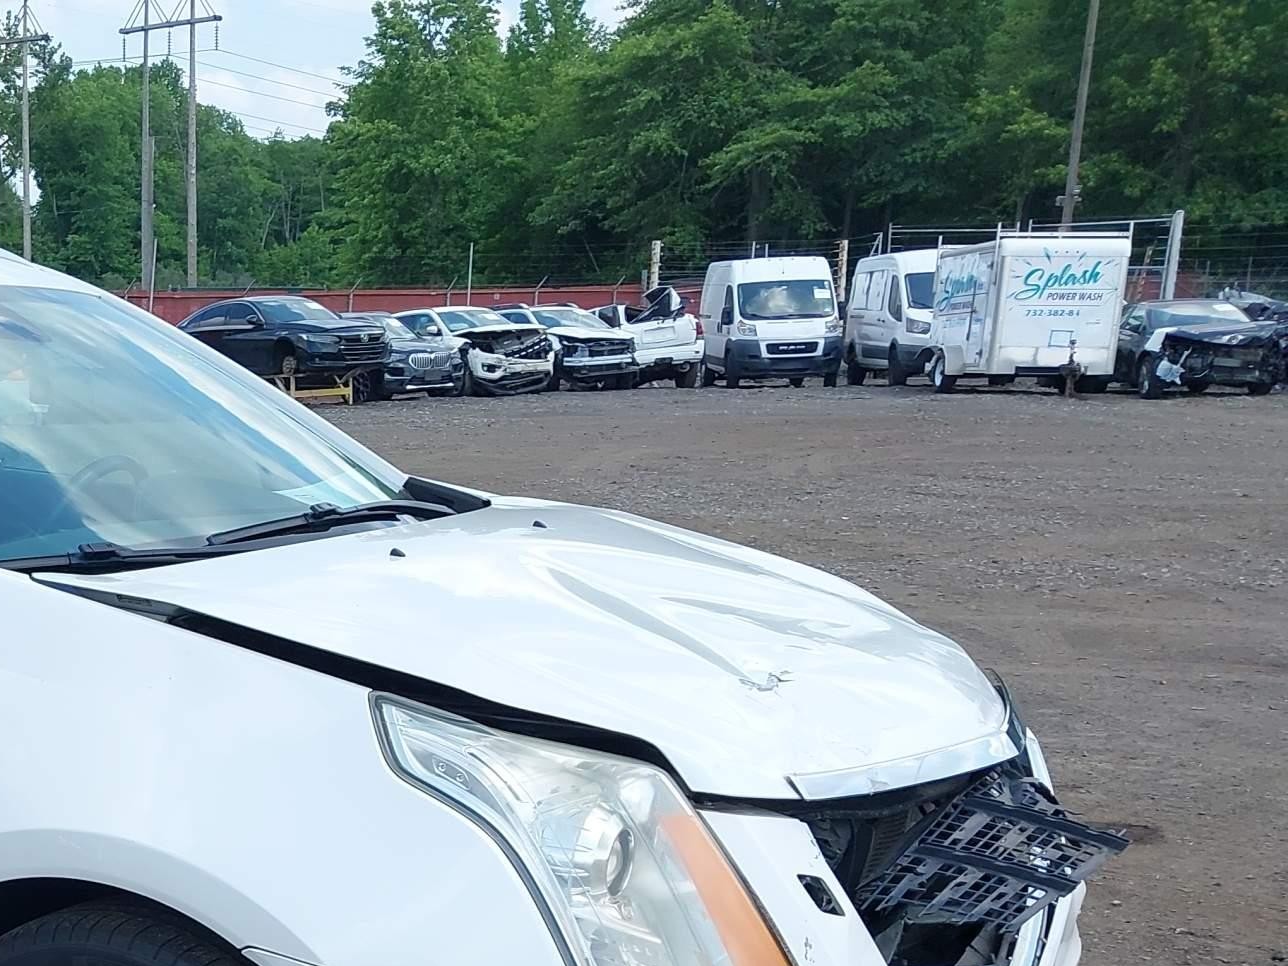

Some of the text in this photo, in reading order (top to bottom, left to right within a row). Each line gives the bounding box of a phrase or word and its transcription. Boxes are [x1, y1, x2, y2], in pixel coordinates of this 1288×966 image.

[1014, 261, 1103, 300] Splash
[1046, 292, 1104, 301] POWER WASH
